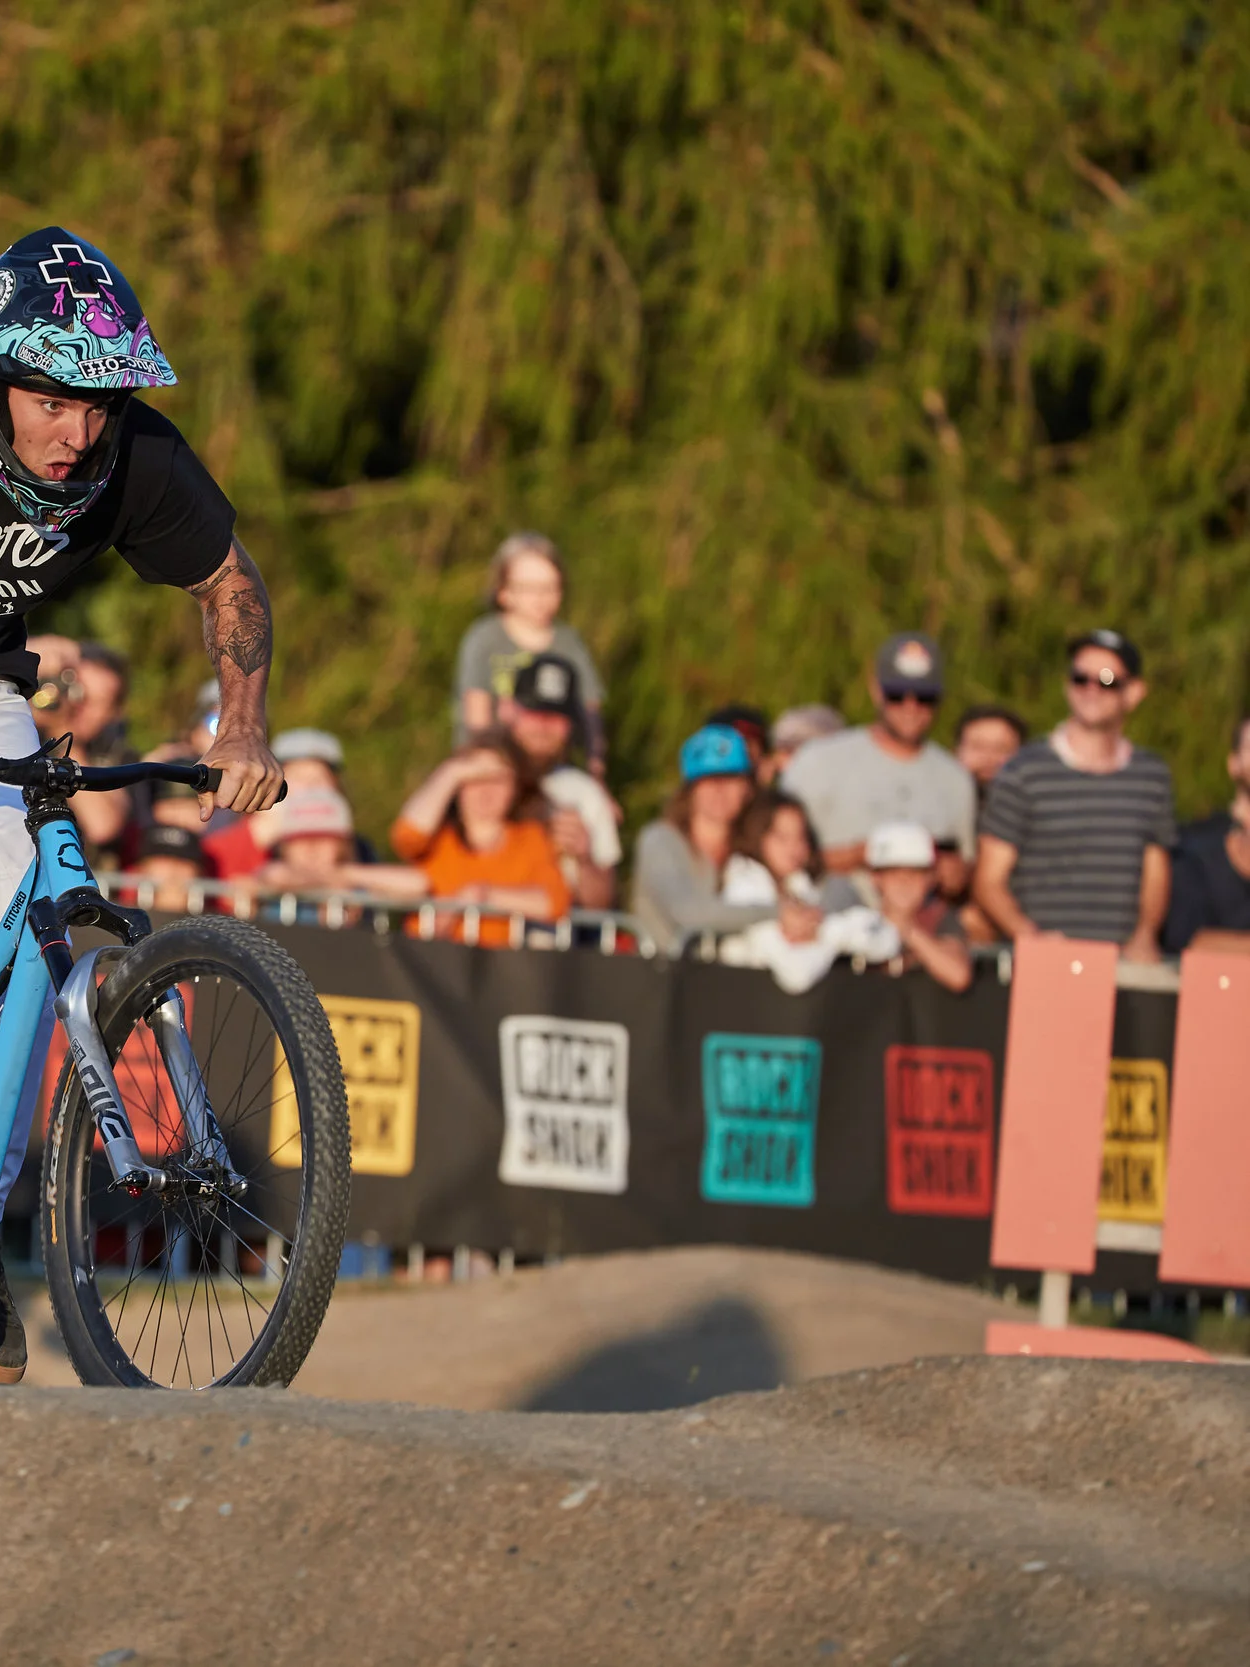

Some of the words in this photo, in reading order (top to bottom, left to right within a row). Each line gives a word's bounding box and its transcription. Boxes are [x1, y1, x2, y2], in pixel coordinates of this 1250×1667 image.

[85, 358, 158, 377] Muc-Off
[3, 891, 27, 931] STITCHED
[79, 1064, 134, 1145] PIKE
